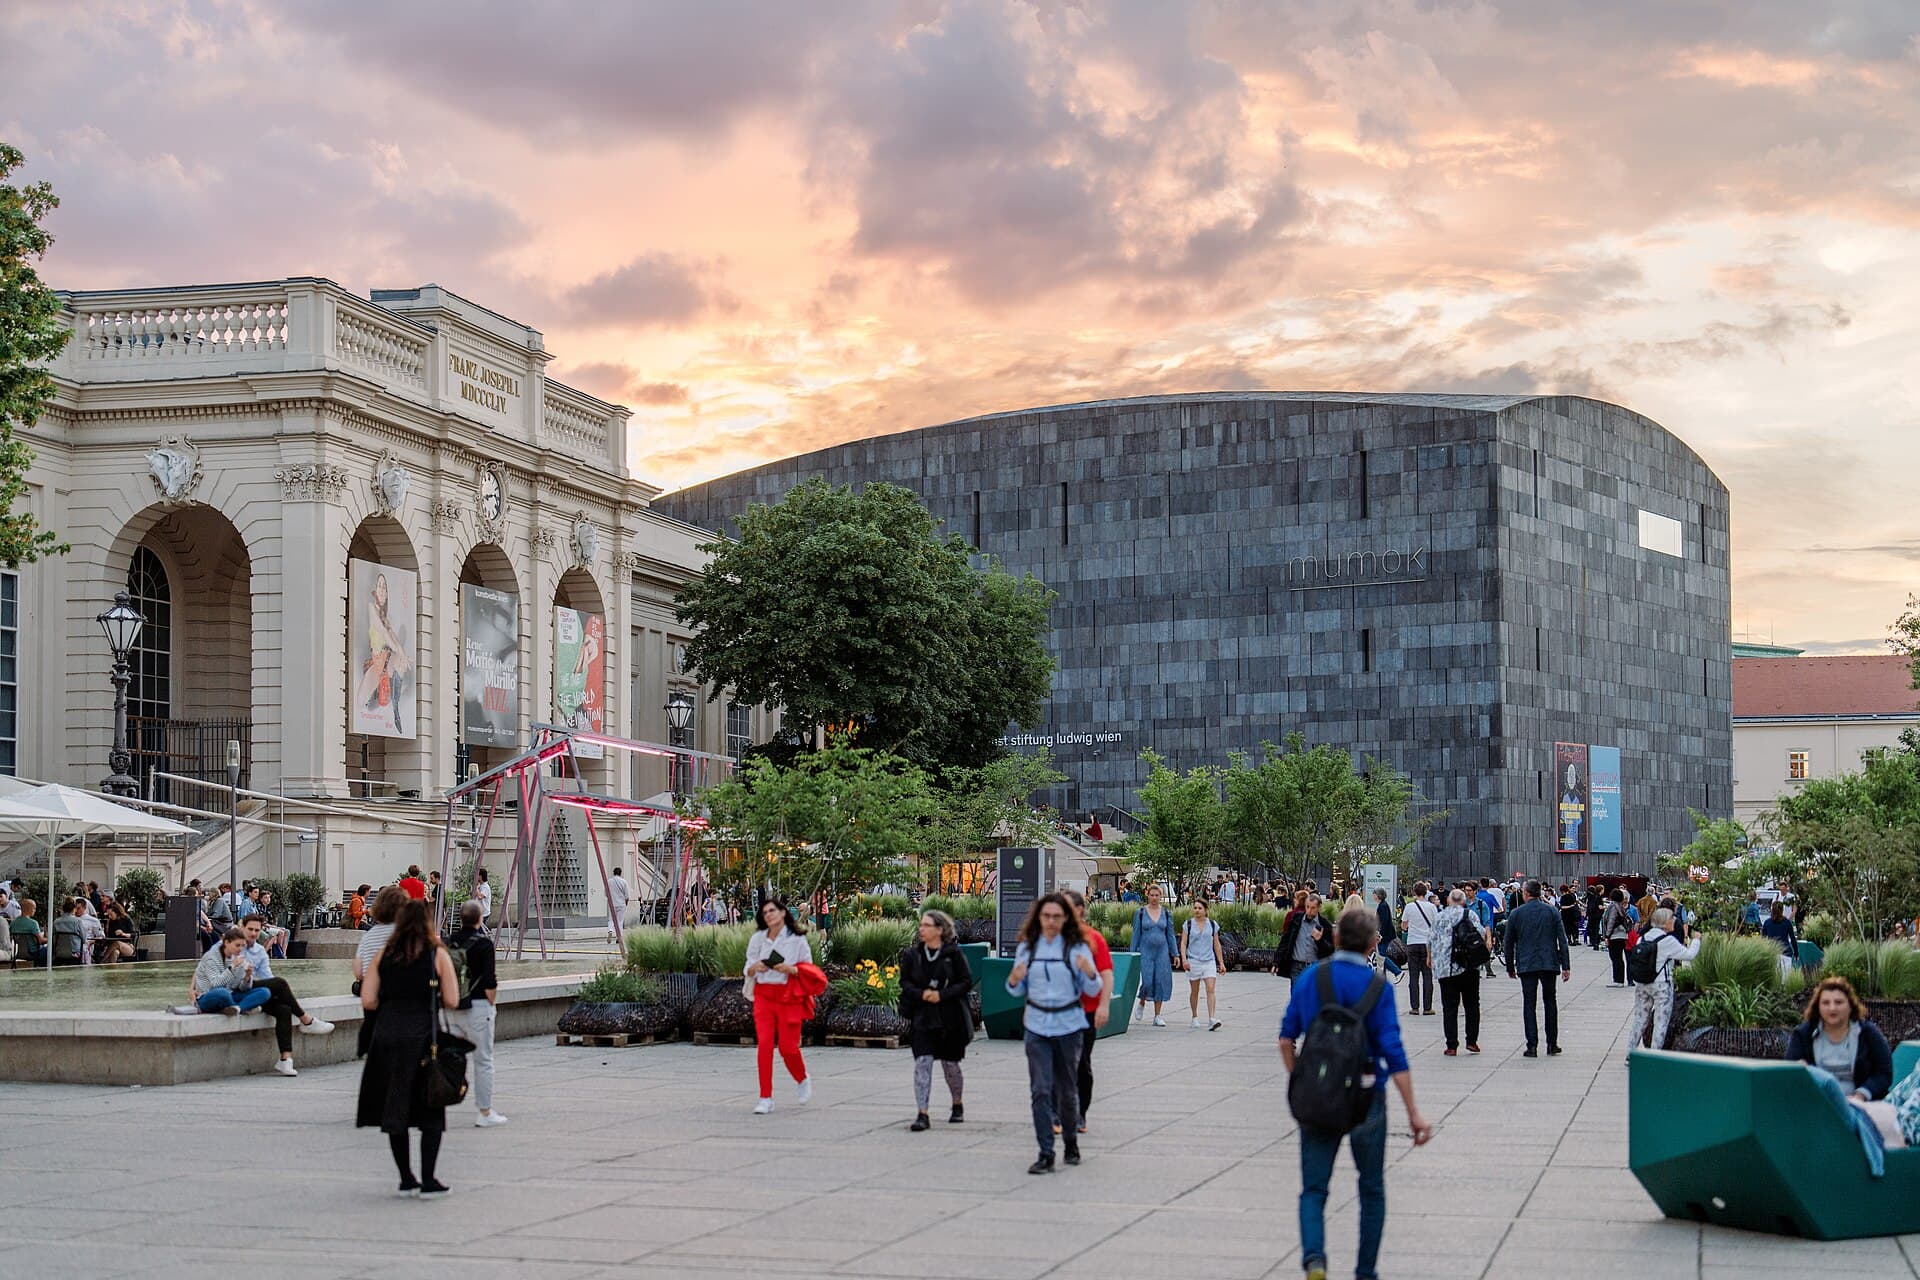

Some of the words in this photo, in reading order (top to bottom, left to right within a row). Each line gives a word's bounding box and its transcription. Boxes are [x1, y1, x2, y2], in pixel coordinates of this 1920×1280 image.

[449, 353, 478, 380] FRANZ
[480, 366, 514, 396] JOSEPH
[1289, 541, 1425, 581] mumok
[485, 669, 516, 690] Murillo
[573, 688, 596, 705] WORLD
[1010, 734, 1053, 747] stiftung
[1056, 732, 1092, 745] ludwig
[1096, 730, 1122, 742] wien
